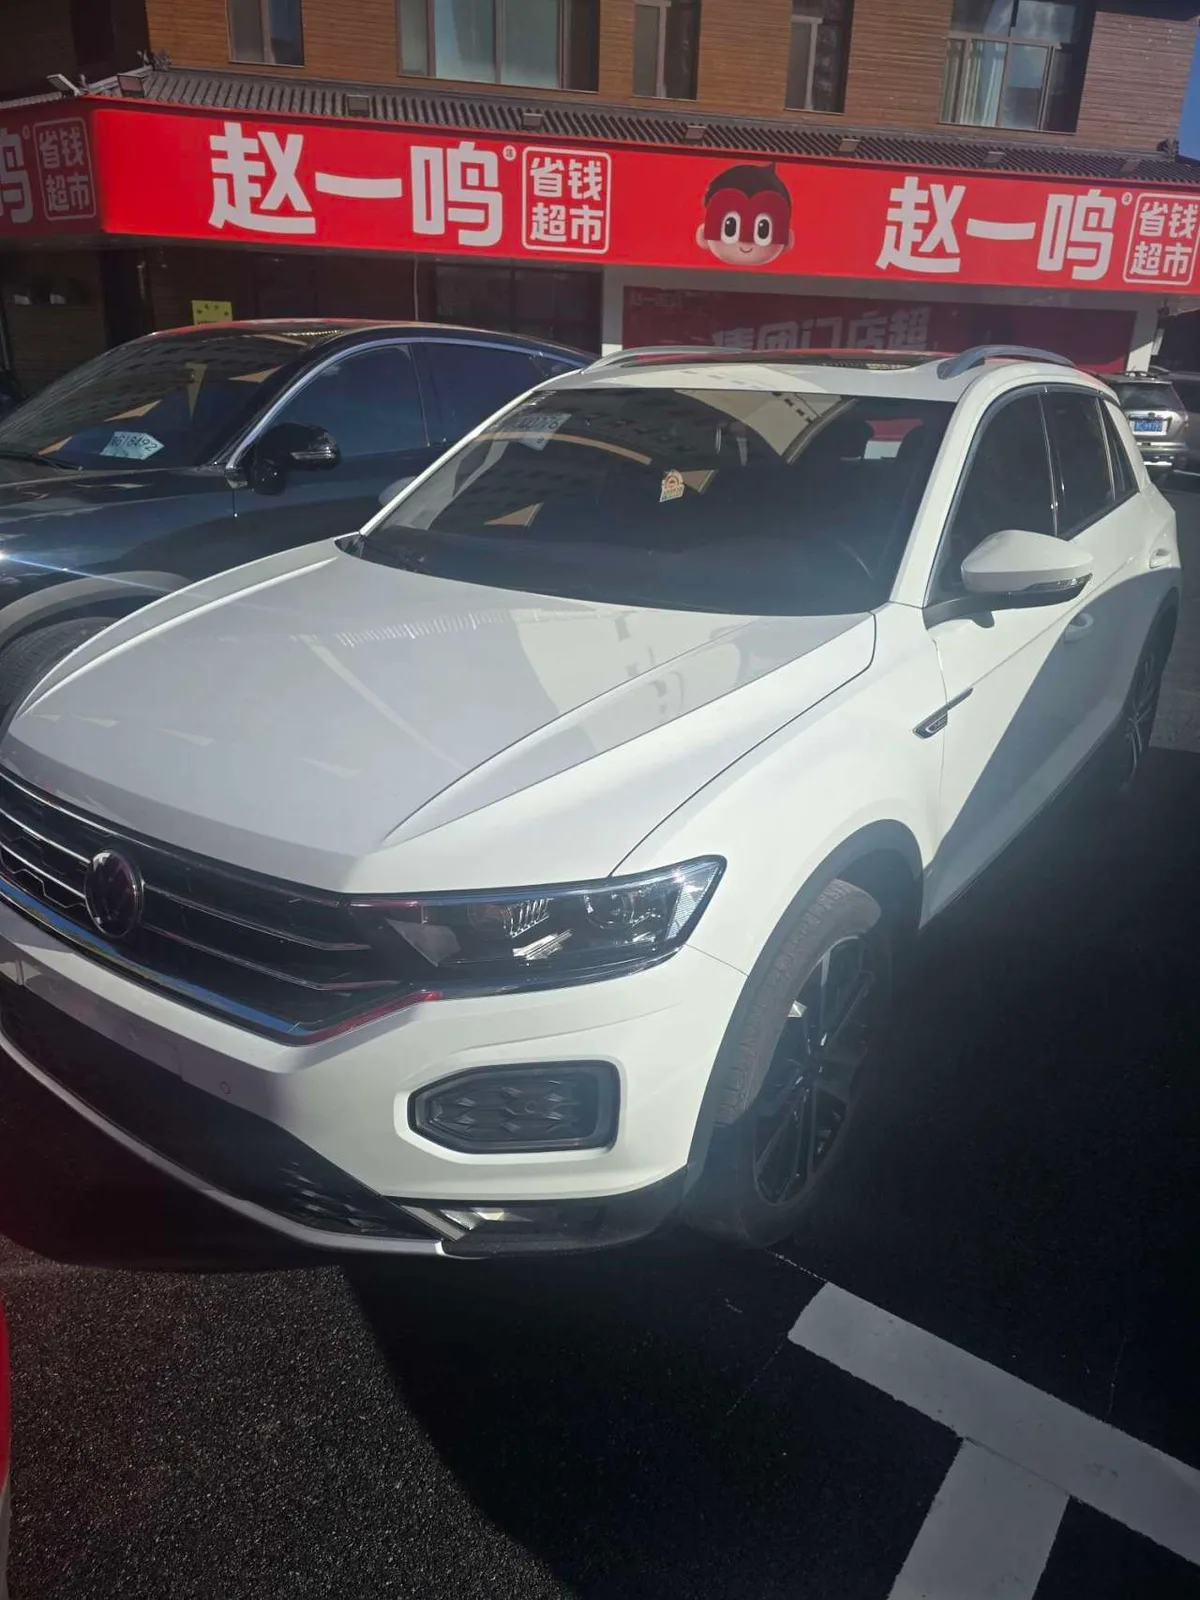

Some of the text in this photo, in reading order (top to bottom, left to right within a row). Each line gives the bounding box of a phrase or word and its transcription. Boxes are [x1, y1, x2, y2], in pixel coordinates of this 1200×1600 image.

[40, 126, 85, 169] 省钱
[45, 173, 89, 212] 超市
[208, 121, 503, 247] 赵一鸣
[530, 157, 603, 201] 省钱
[530, 202, 604, 244] 超市
[875, 175, 1117, 281] 赵一鸣
[1139, 201, 1199, 239] 省钱
[1129, 241, 1193, 278] 超市
